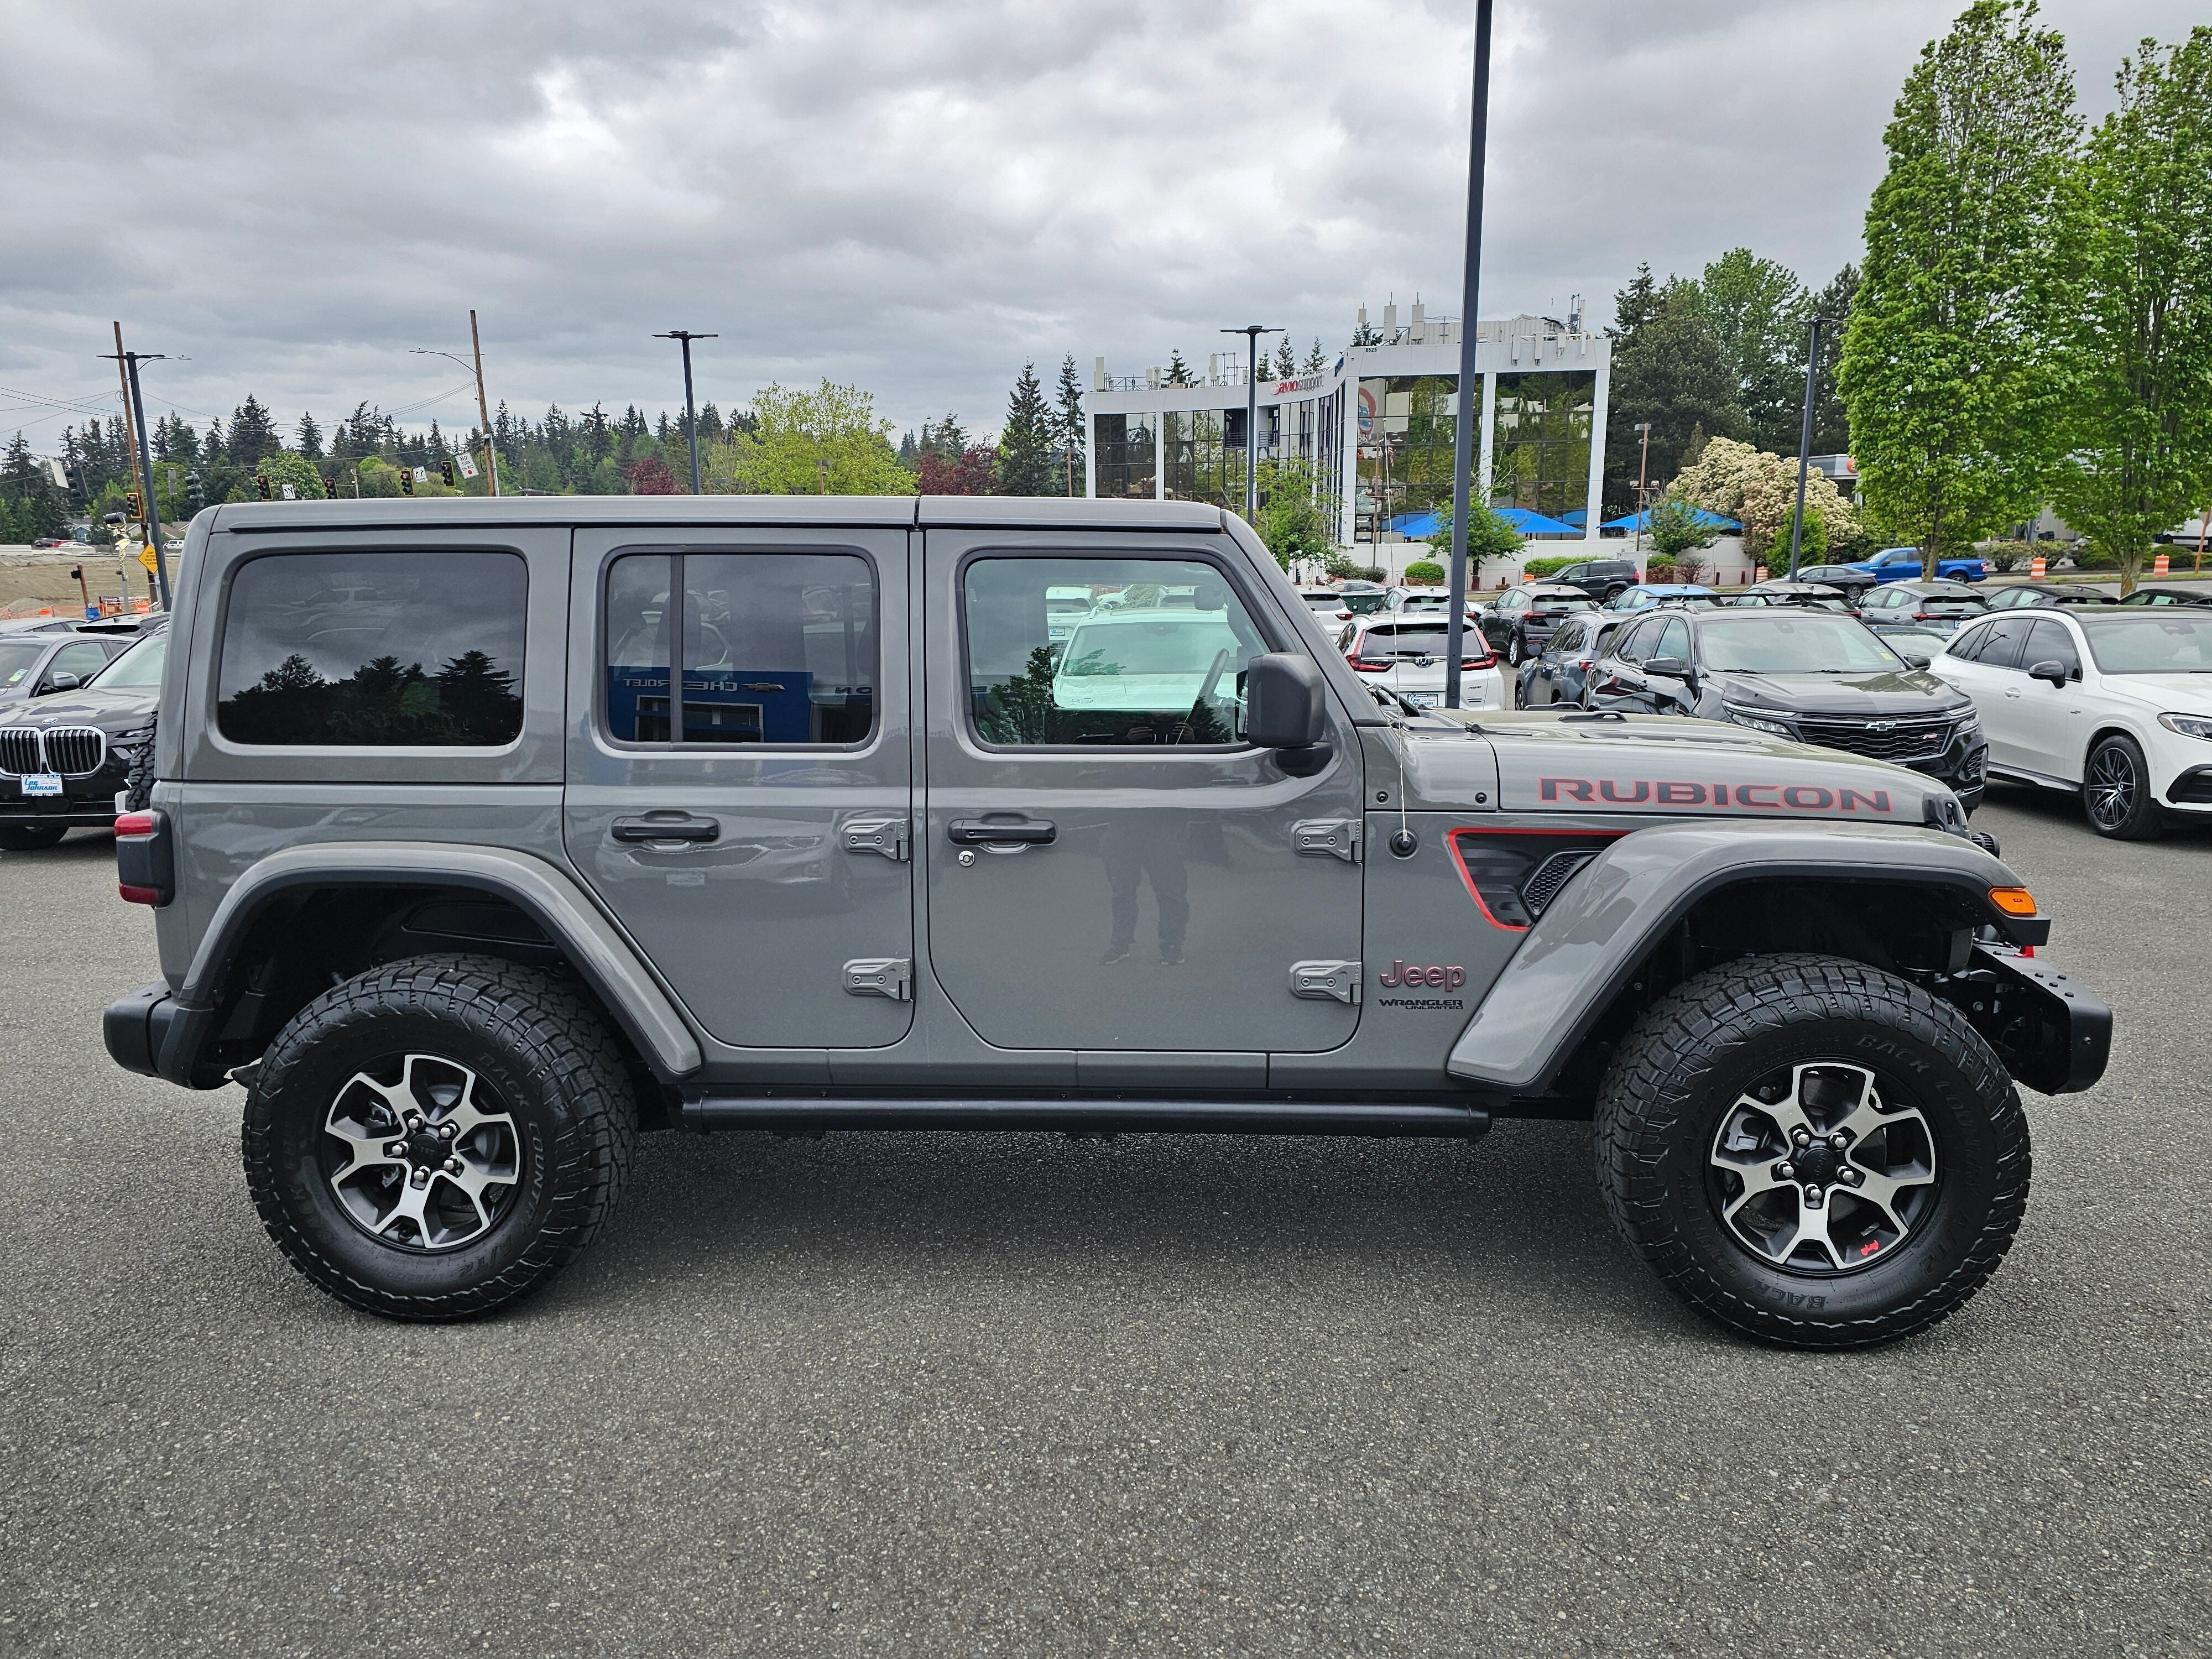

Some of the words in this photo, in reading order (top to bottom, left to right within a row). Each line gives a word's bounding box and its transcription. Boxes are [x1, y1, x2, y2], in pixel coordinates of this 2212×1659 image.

[1539, 777, 1893, 813] RUBICON
[1380, 960, 1466, 993] Jeep
[1855, 1035, 1932, 1073] BACK
[478, 1053, 529, 1106] BACK
[1814, 1154, 1828, 1176] Jeep
[1747, 1278, 1826, 1311] BACK
